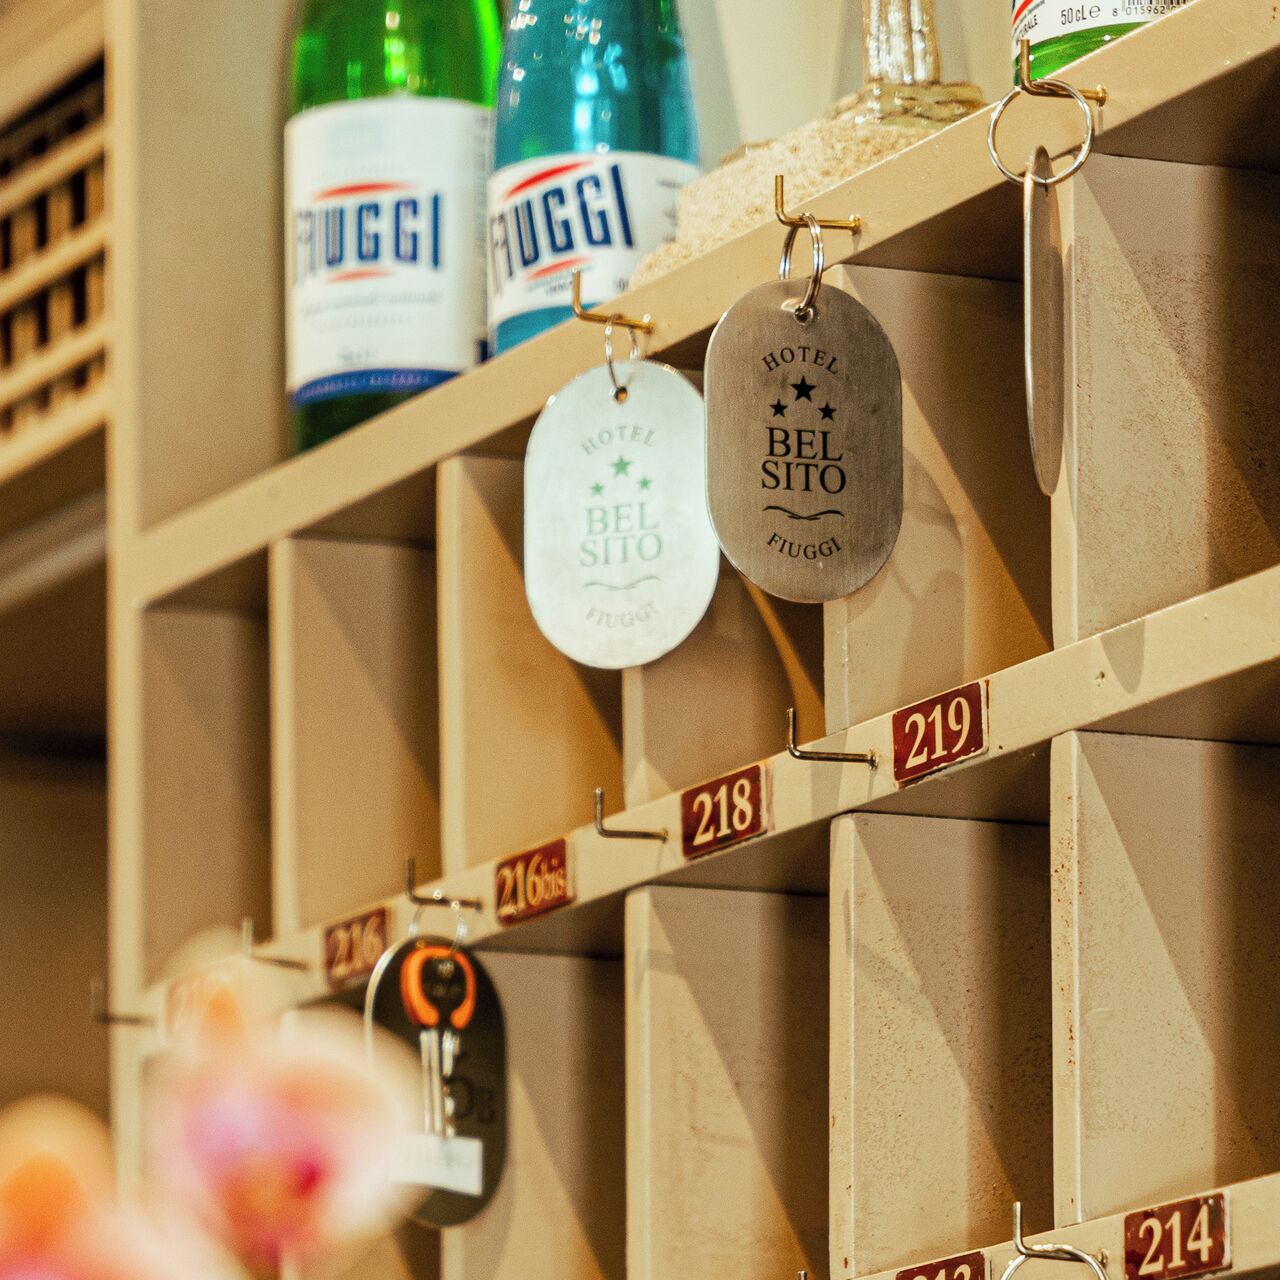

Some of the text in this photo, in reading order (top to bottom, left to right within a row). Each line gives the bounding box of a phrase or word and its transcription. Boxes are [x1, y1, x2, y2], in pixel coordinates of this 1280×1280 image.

[761, 346, 840, 376] HOTEL
[581, 424, 658, 457] HOTEL
[765, 427, 844, 462] BEL
[760, 462, 847, 495] SITO
[587, 502, 659, 537] BEL
[579, 533, 664, 569] SITO
[766, 532, 843, 562] FIUGGI
[585, 600, 659, 629] FIUGGI
[904, 696, 972, 768] 219
[692, 777, 753, 846] 218
[497, 852, 566, 916] 216bis
[330, 914, 384, 978] 216
[1137, 1208, 1212, 1277] 214
